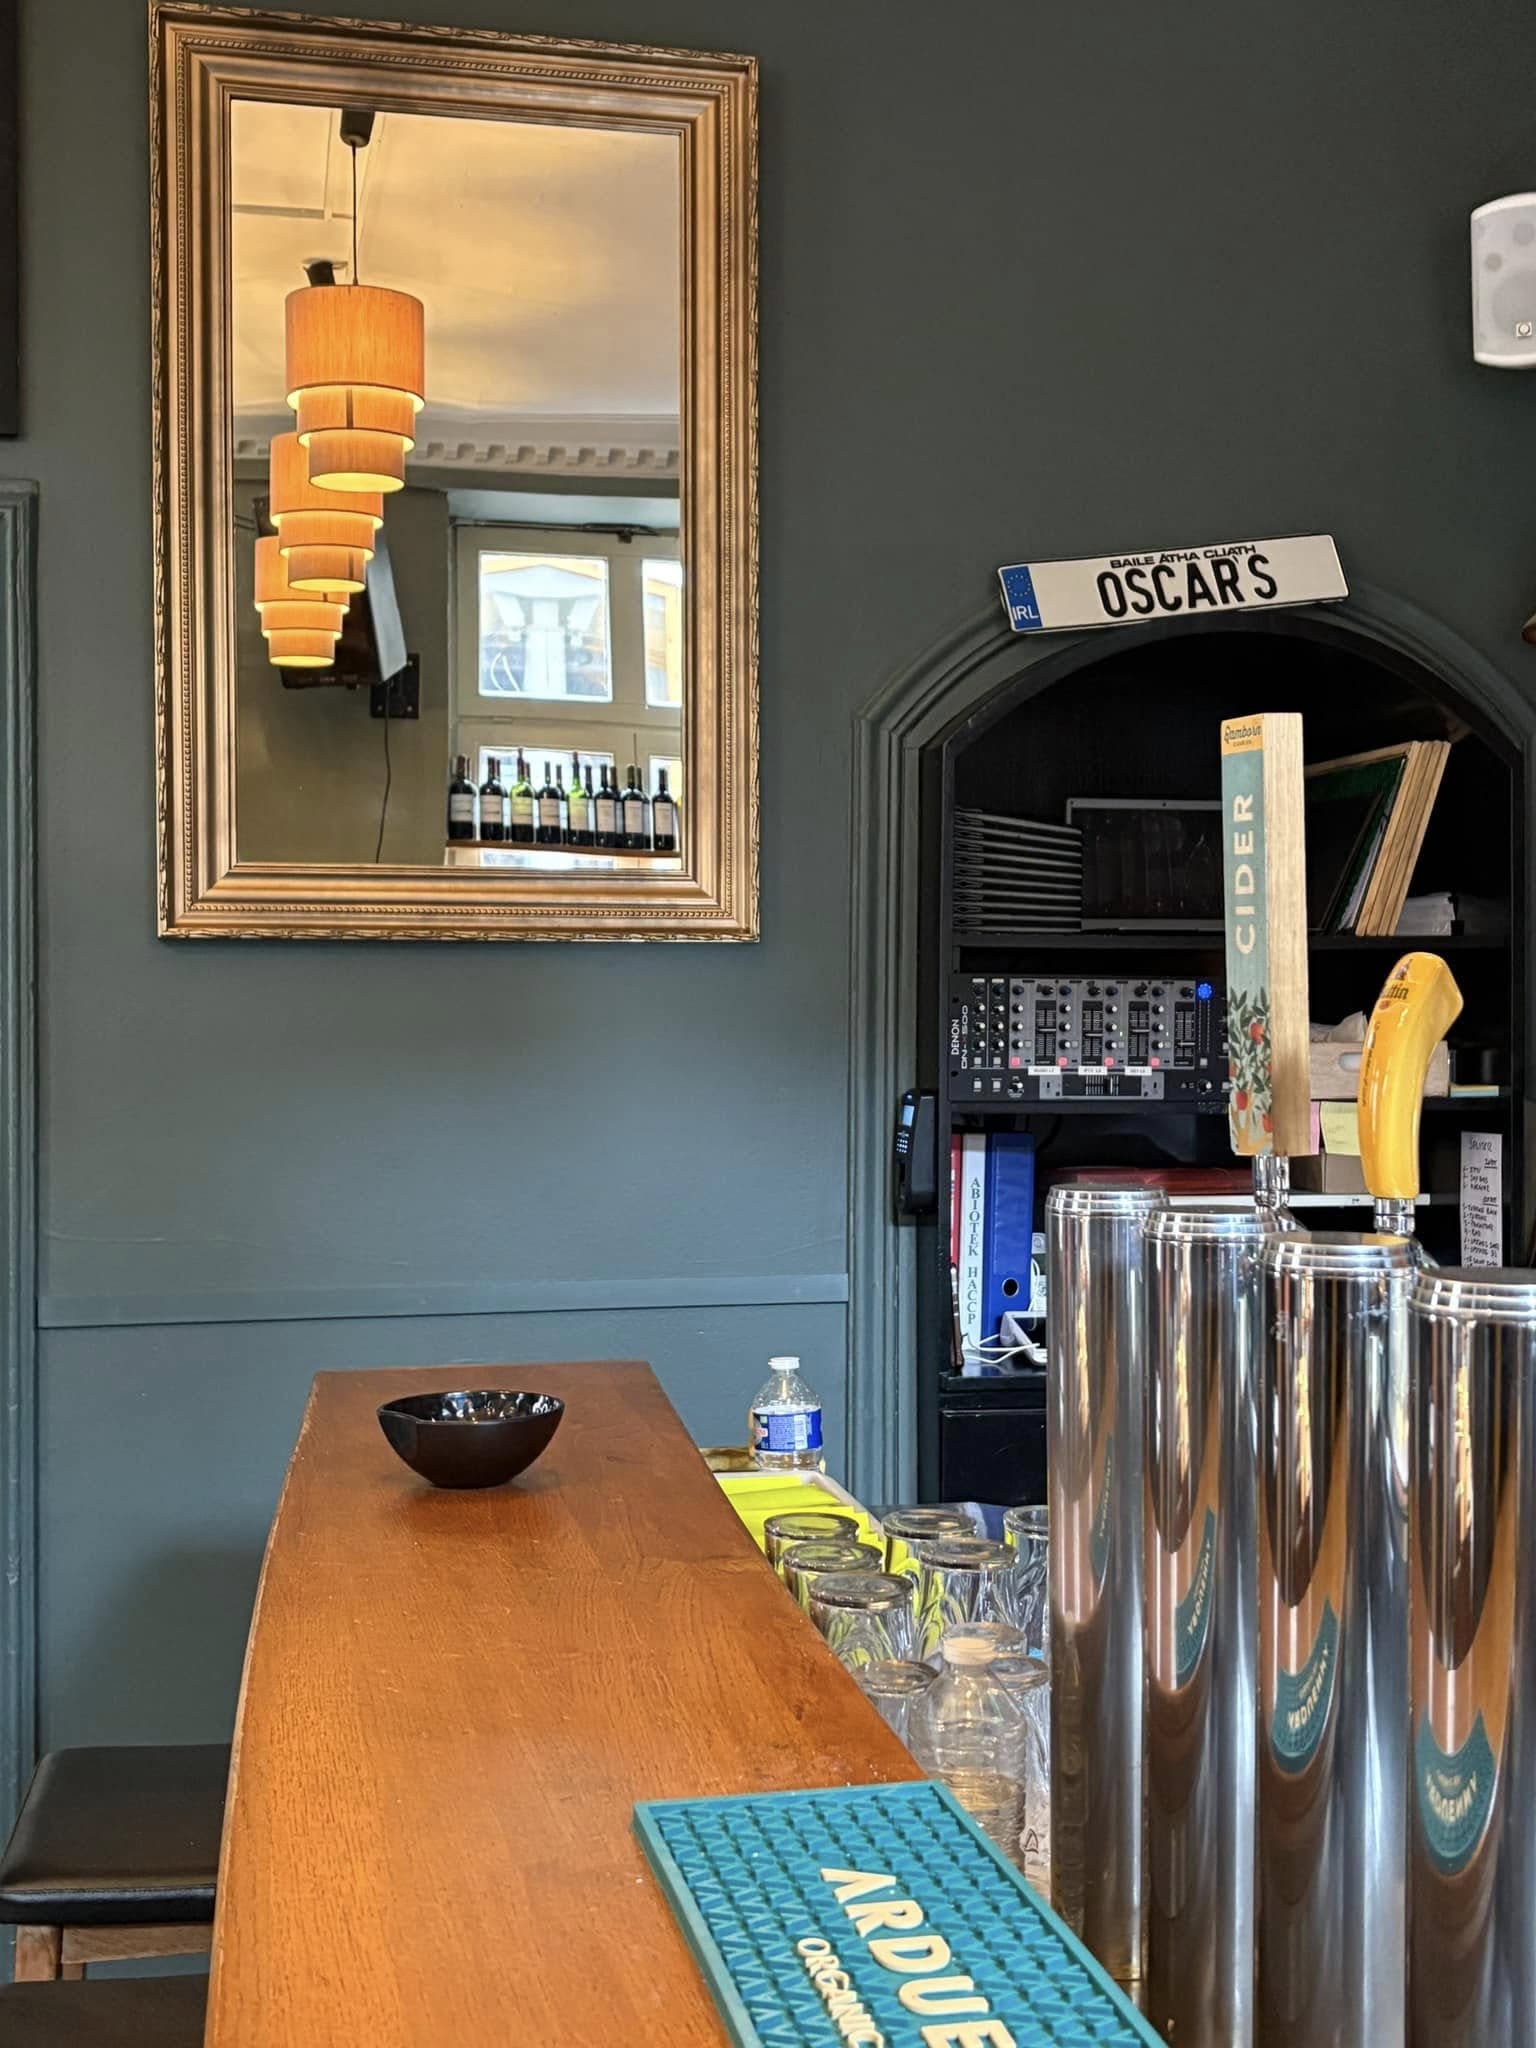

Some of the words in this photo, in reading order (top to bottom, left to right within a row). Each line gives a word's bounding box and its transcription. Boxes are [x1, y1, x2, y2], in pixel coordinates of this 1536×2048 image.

[1096, 553, 1278, 618] OSCAR'S
[1110, 554, 1155, 570] BAILE
[1159, 549, 1200, 565] ÁTHA
[1203, 545, 1257, 560] CLIATH
[1012, 605, 1038, 622] IRL
[1233, 794, 1256, 955] CIDER
[951, 1019, 960, 1056] DENON
[968, 1177, 981, 1257] ABIOTEK
[966, 1266, 979, 1325] HACCP
